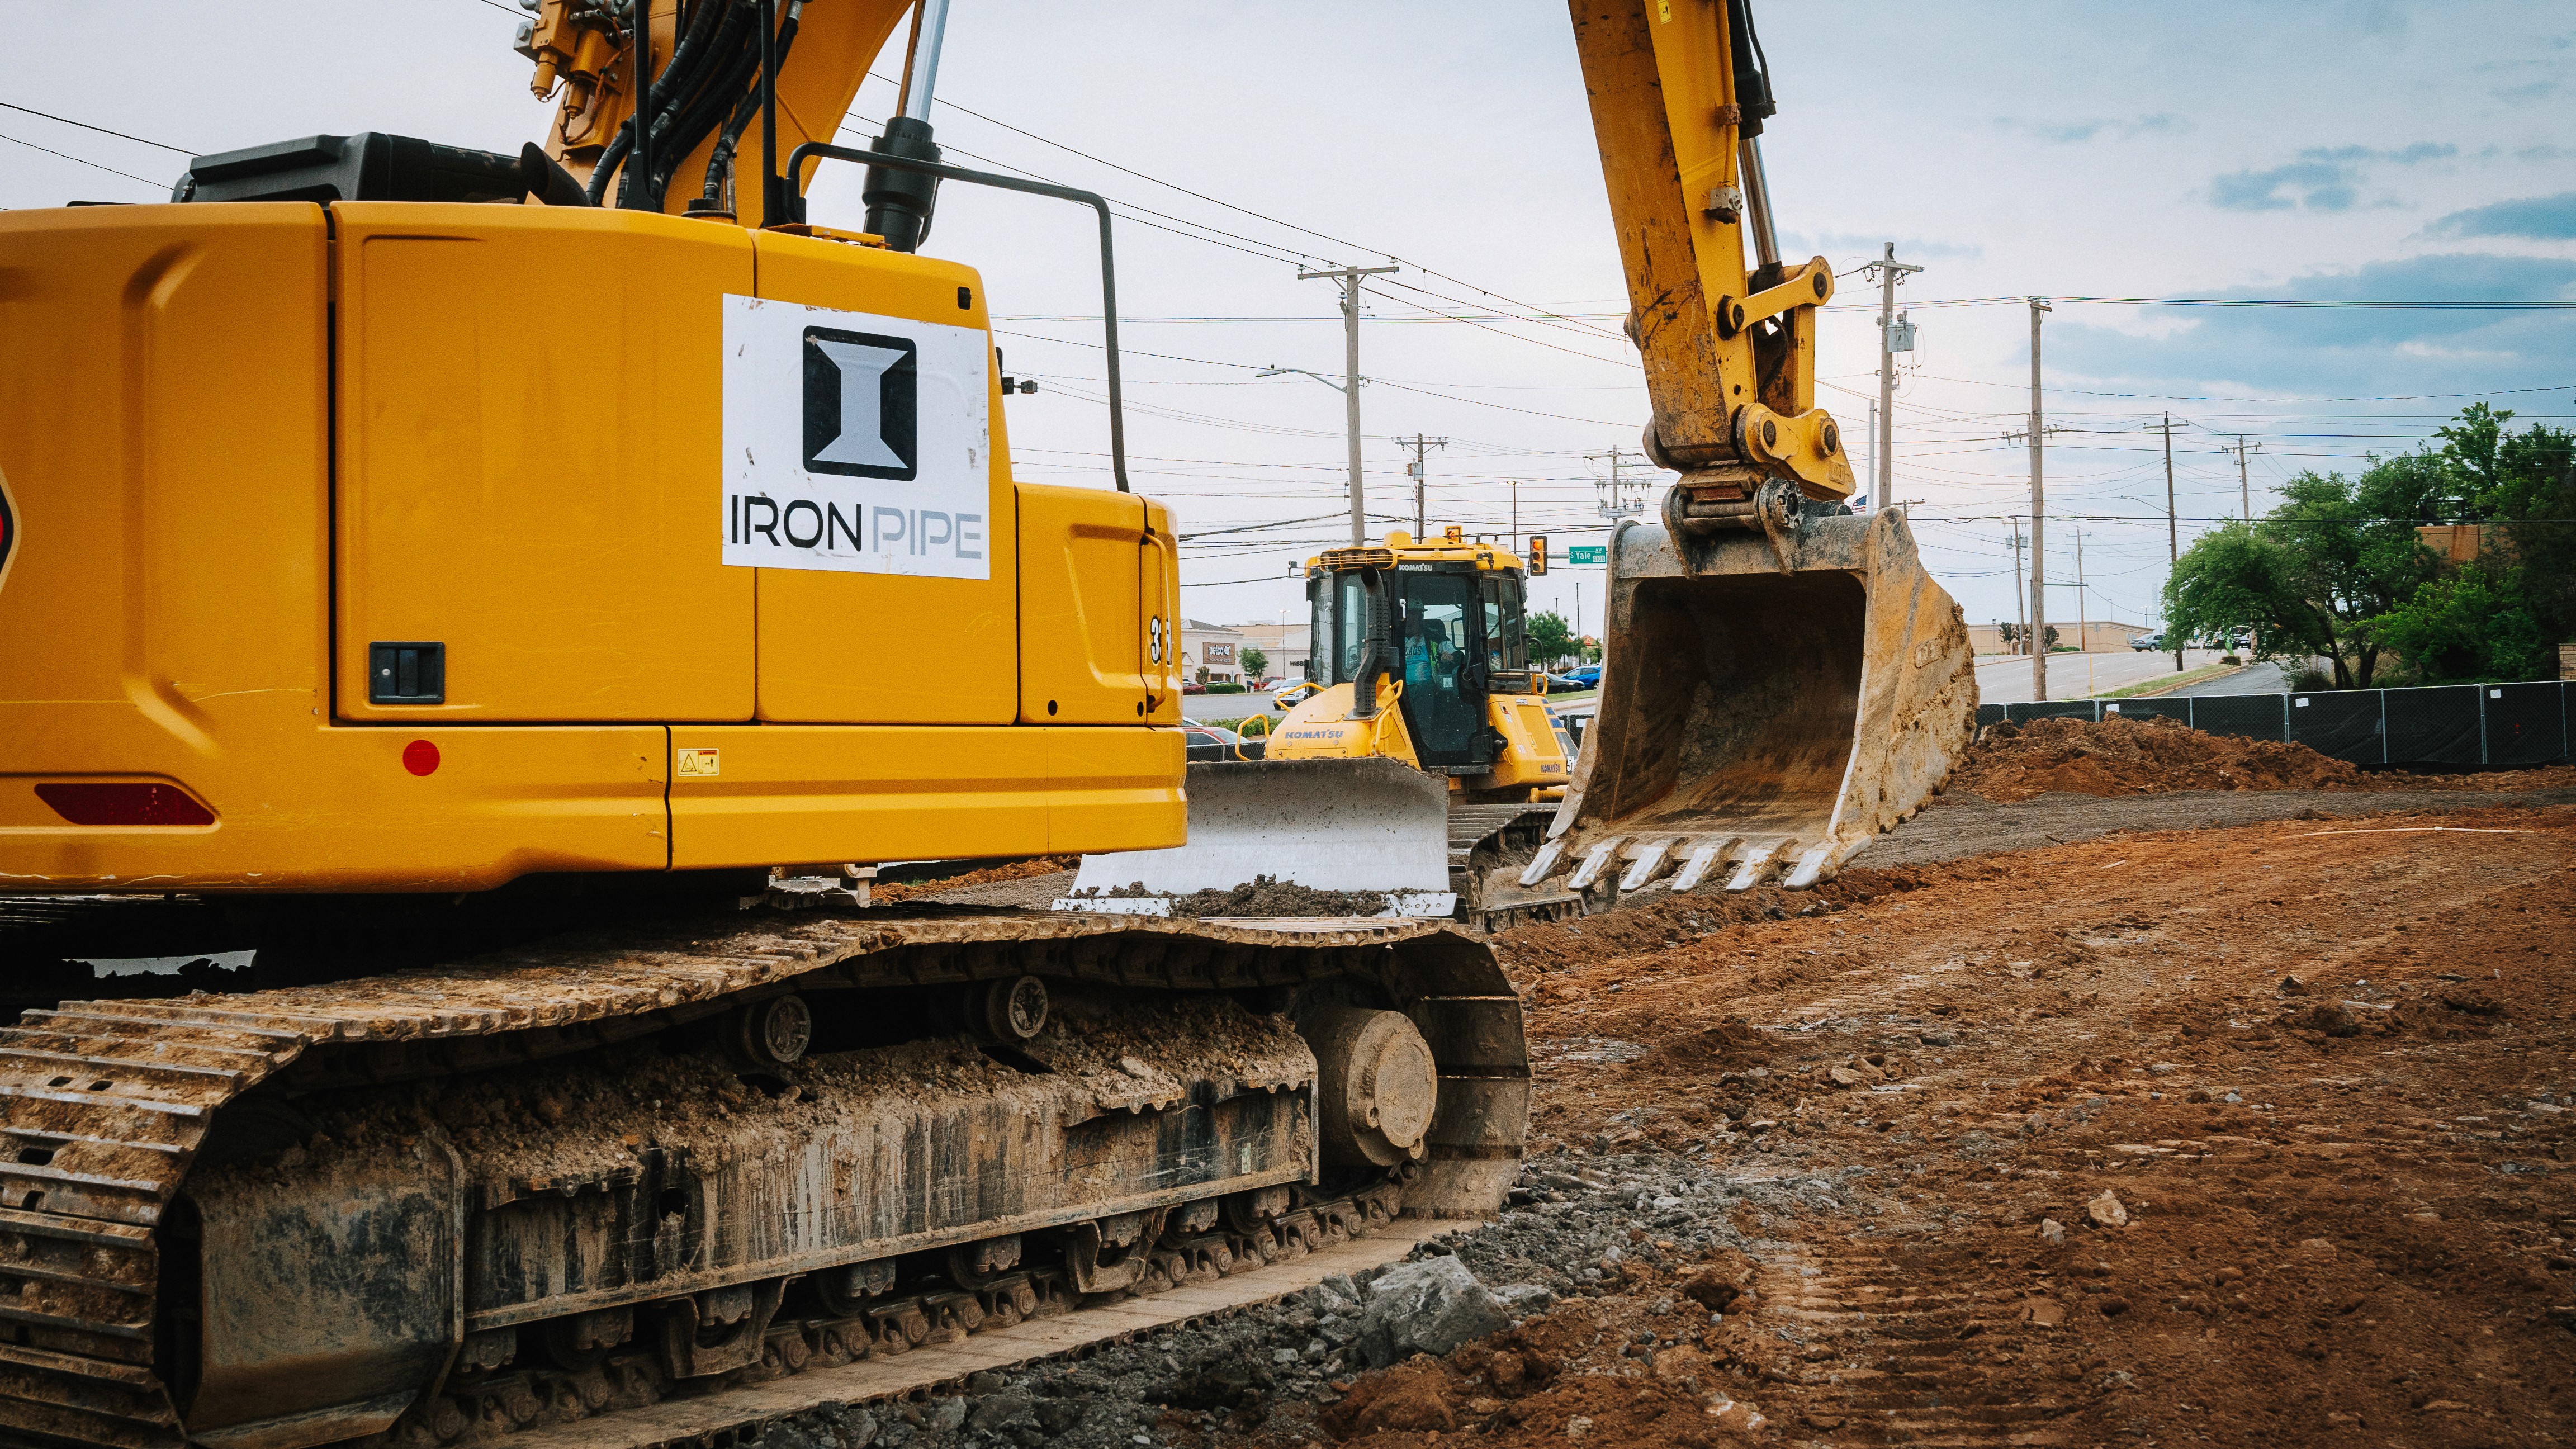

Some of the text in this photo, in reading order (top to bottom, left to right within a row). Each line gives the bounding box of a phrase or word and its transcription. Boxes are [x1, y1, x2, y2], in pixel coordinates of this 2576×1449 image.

[732, 494, 982, 559] IRON PIPE
[1575, 551, 1591, 560] Yale
[1399, 563, 1433, 571] KOMATSU
[1209, 645, 1224, 657] petco
[1285, 729, 1344, 739] KOMATSU
[1541, 762, 1560, 773] KOMATSU
